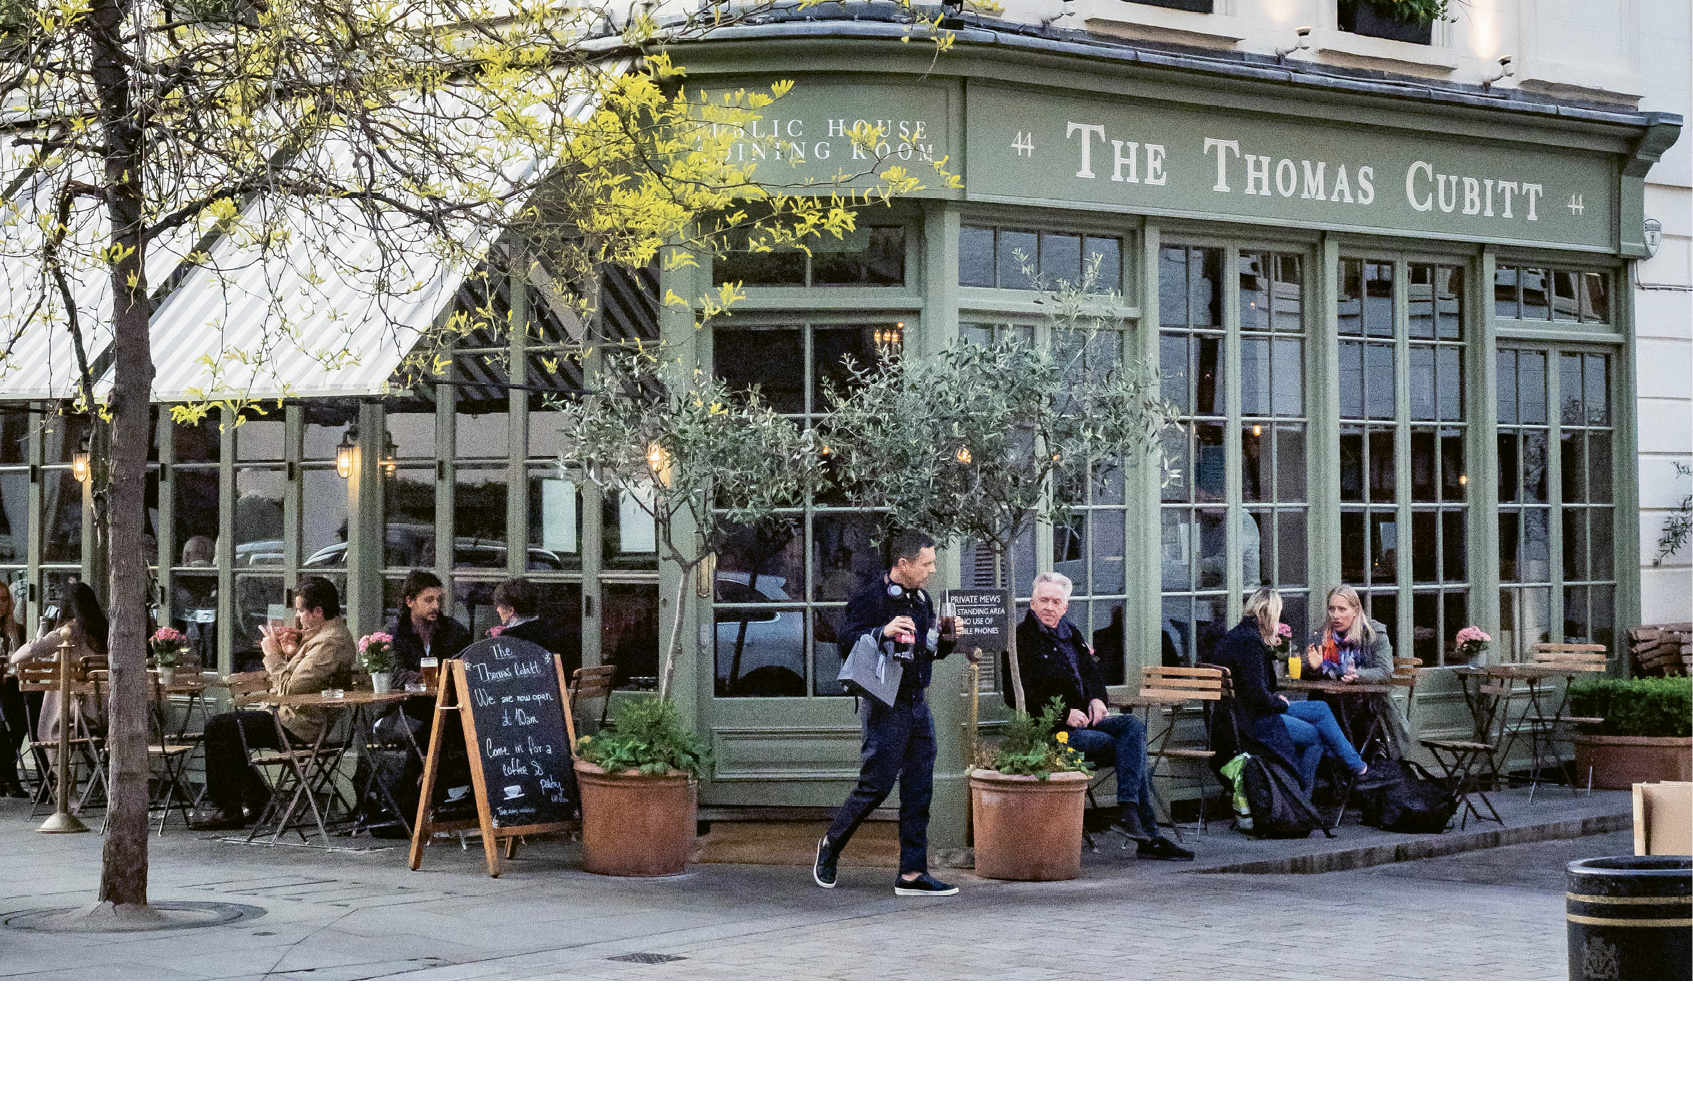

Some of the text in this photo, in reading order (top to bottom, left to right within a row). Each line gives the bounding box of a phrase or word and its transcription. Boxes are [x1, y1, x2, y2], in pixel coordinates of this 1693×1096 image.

[828, 119, 927, 139] HOUSE
[1011, 130, 1035, 157] 44
[1567, 194, 1585, 216] 44
[951, 595, 1001, 603] PRIVATE MEWS
[974, 627, 999, 635] PHONES
[474, 688, 495, 707] We
[501, 696, 514, 704] are
[532, 692, 554, 706] open
[486, 736, 553, 758] Come in for a
